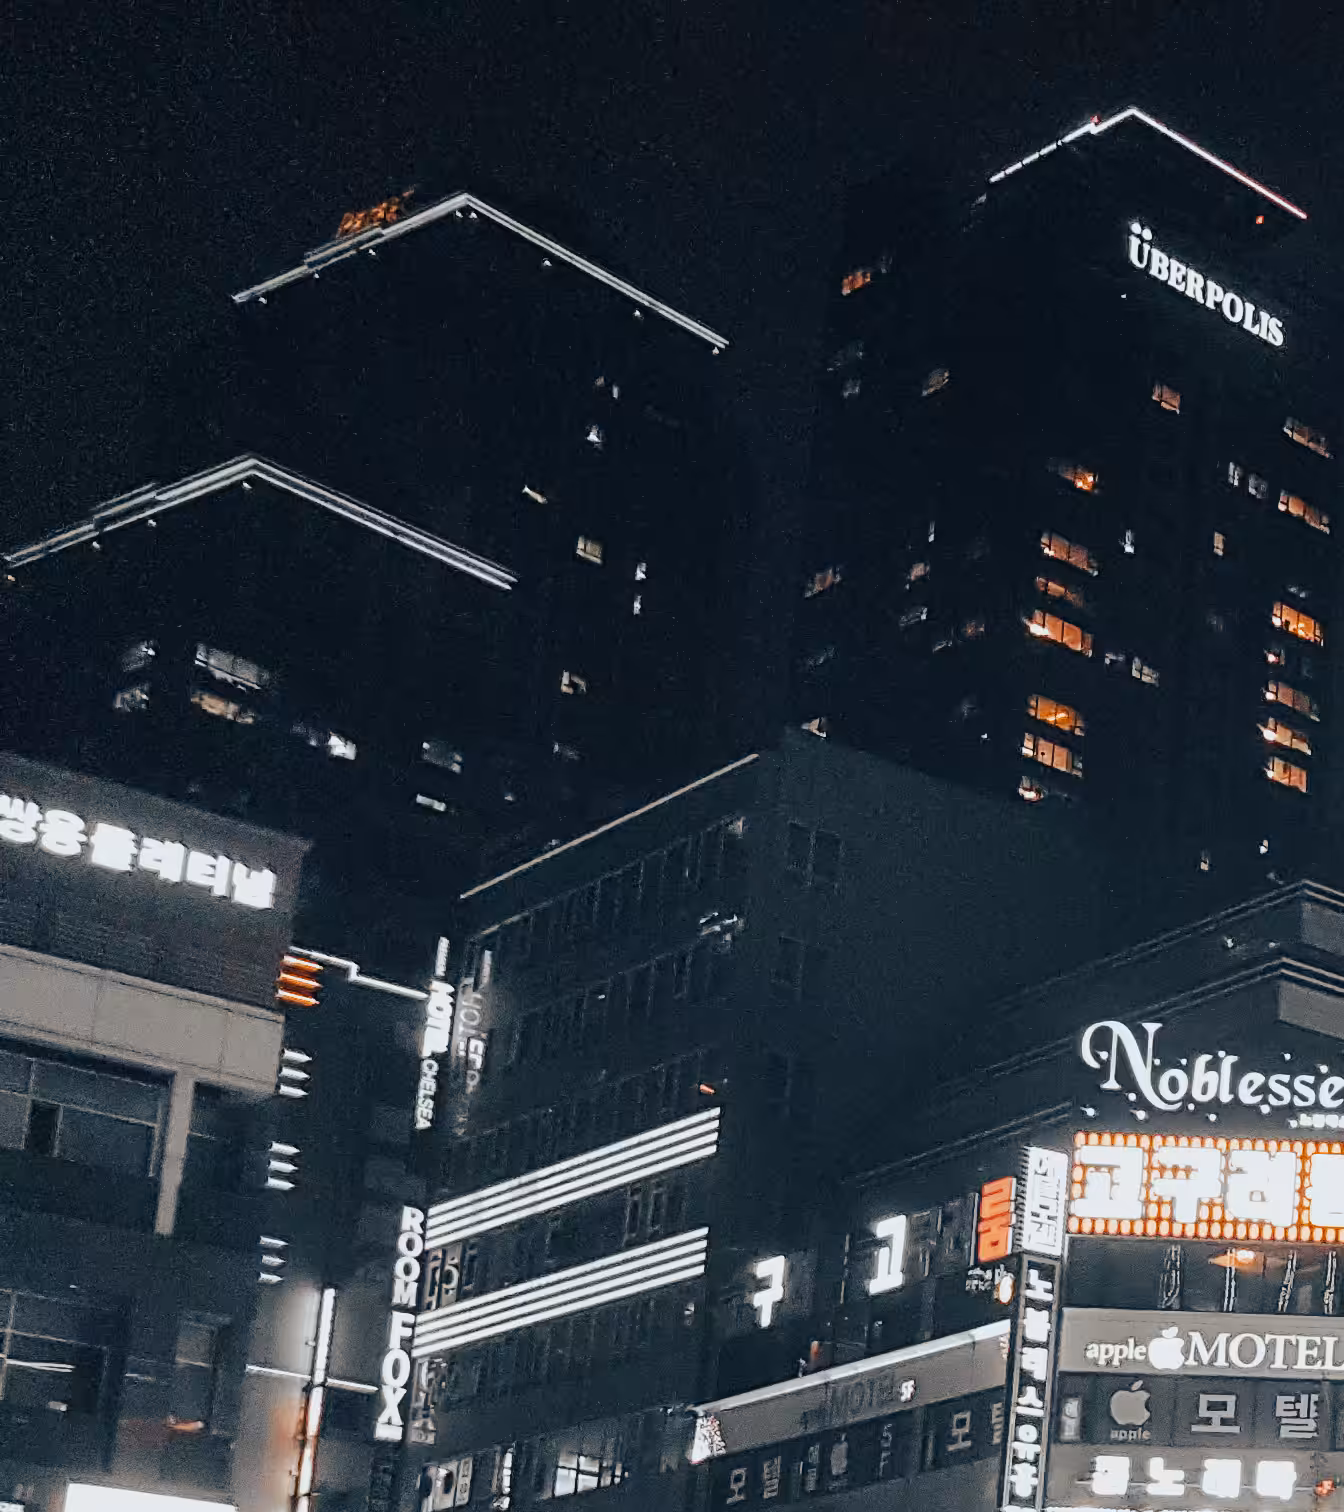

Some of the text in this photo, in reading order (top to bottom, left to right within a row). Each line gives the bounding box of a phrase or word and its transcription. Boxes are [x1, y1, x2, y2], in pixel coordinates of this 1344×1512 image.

[1128, 221, 1284, 347] ÜBERPOLIS
[415, 1058, 440, 1130] CHELSEA
[391, 1205, 424, 1307] ROOM
[376, 1309, 415, 1426] FOX
[1086, 1342, 1146, 1363] apple
[1191, 1393, 1319, 1439] 모텔
